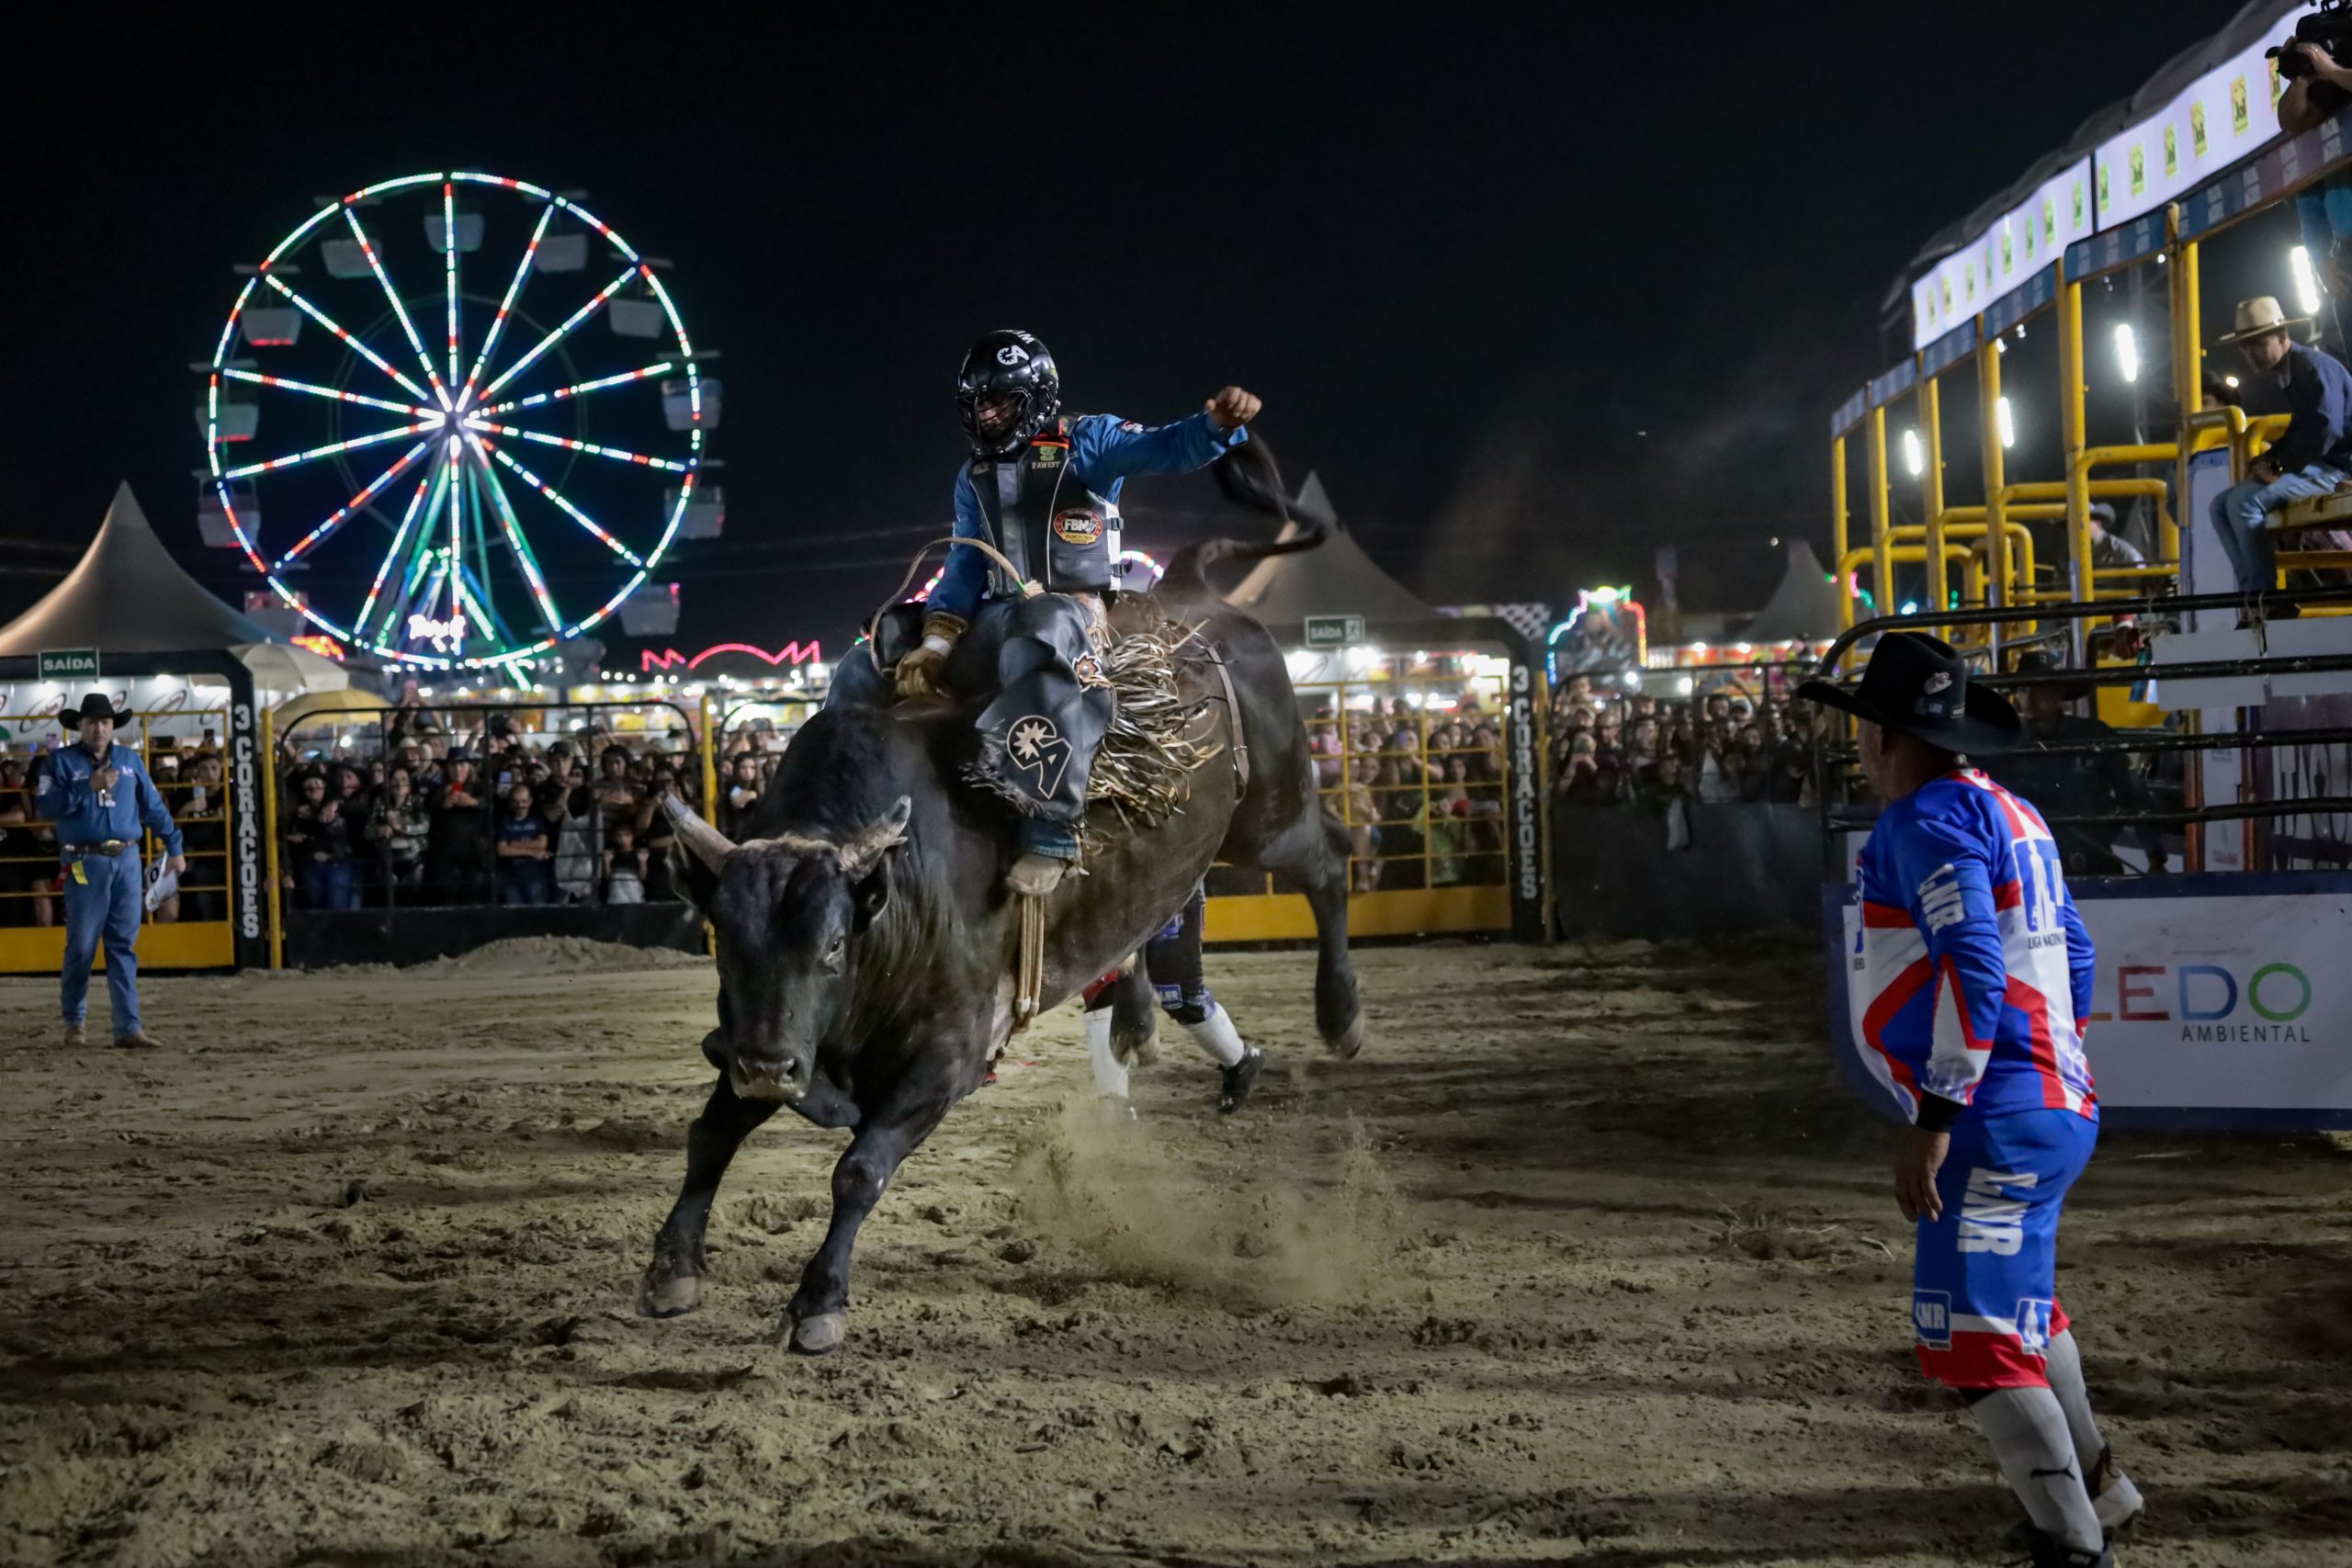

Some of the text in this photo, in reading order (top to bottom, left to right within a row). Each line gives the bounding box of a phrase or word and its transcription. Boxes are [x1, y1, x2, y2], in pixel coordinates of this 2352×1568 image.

[1064, 518, 1090, 532] FBM
[1309, 624, 1343, 640] SAÍDA
[43, 656, 96, 671] SAÍDA
[1512, 665, 1530, 693] 3
[234, 704, 251, 730] 3
[2181, 1024, 2312, 1043] AMBIENTAL
